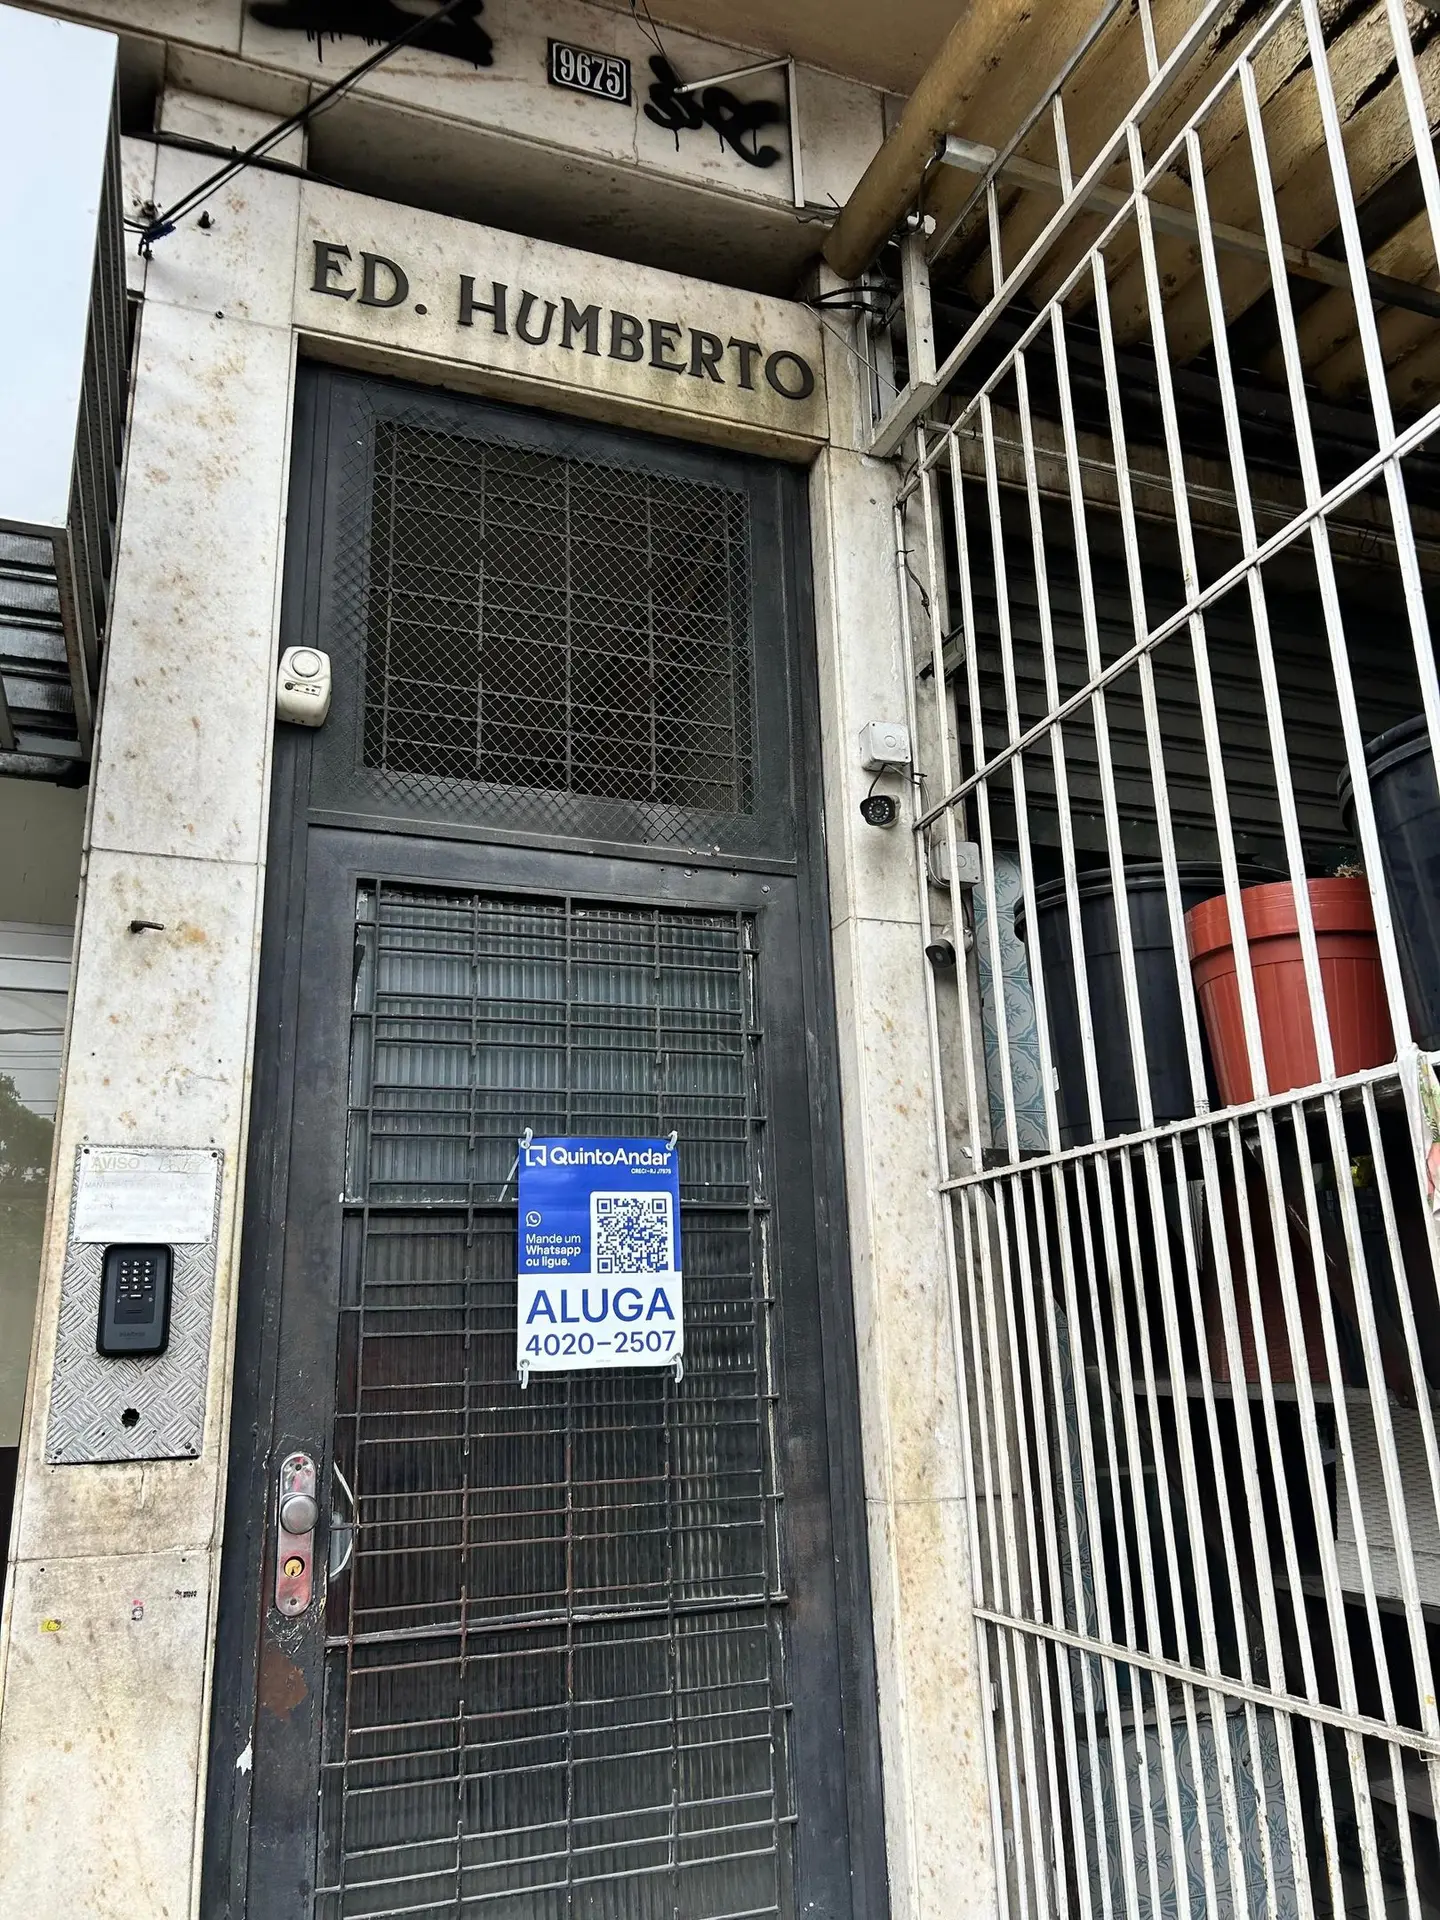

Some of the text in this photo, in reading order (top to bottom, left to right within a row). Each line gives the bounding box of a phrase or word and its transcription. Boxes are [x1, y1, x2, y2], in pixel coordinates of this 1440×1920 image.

[560, 48, 620, 95] 9675
[310, 239, 815, 400] ED. HUMBERTO
[91, 1157, 141, 1170] AVISO
[550, 1146, 672, 1166] QuintoAndar
[525, 1233, 581, 1244] Mande um
[525, 1245, 581, 1257] Whatsapp
[525, 1256, 571, 1269] ou ligue.
[526, 1287, 675, 1324] ALUGA
[525, 1330, 676, 1356] 4020-2507
